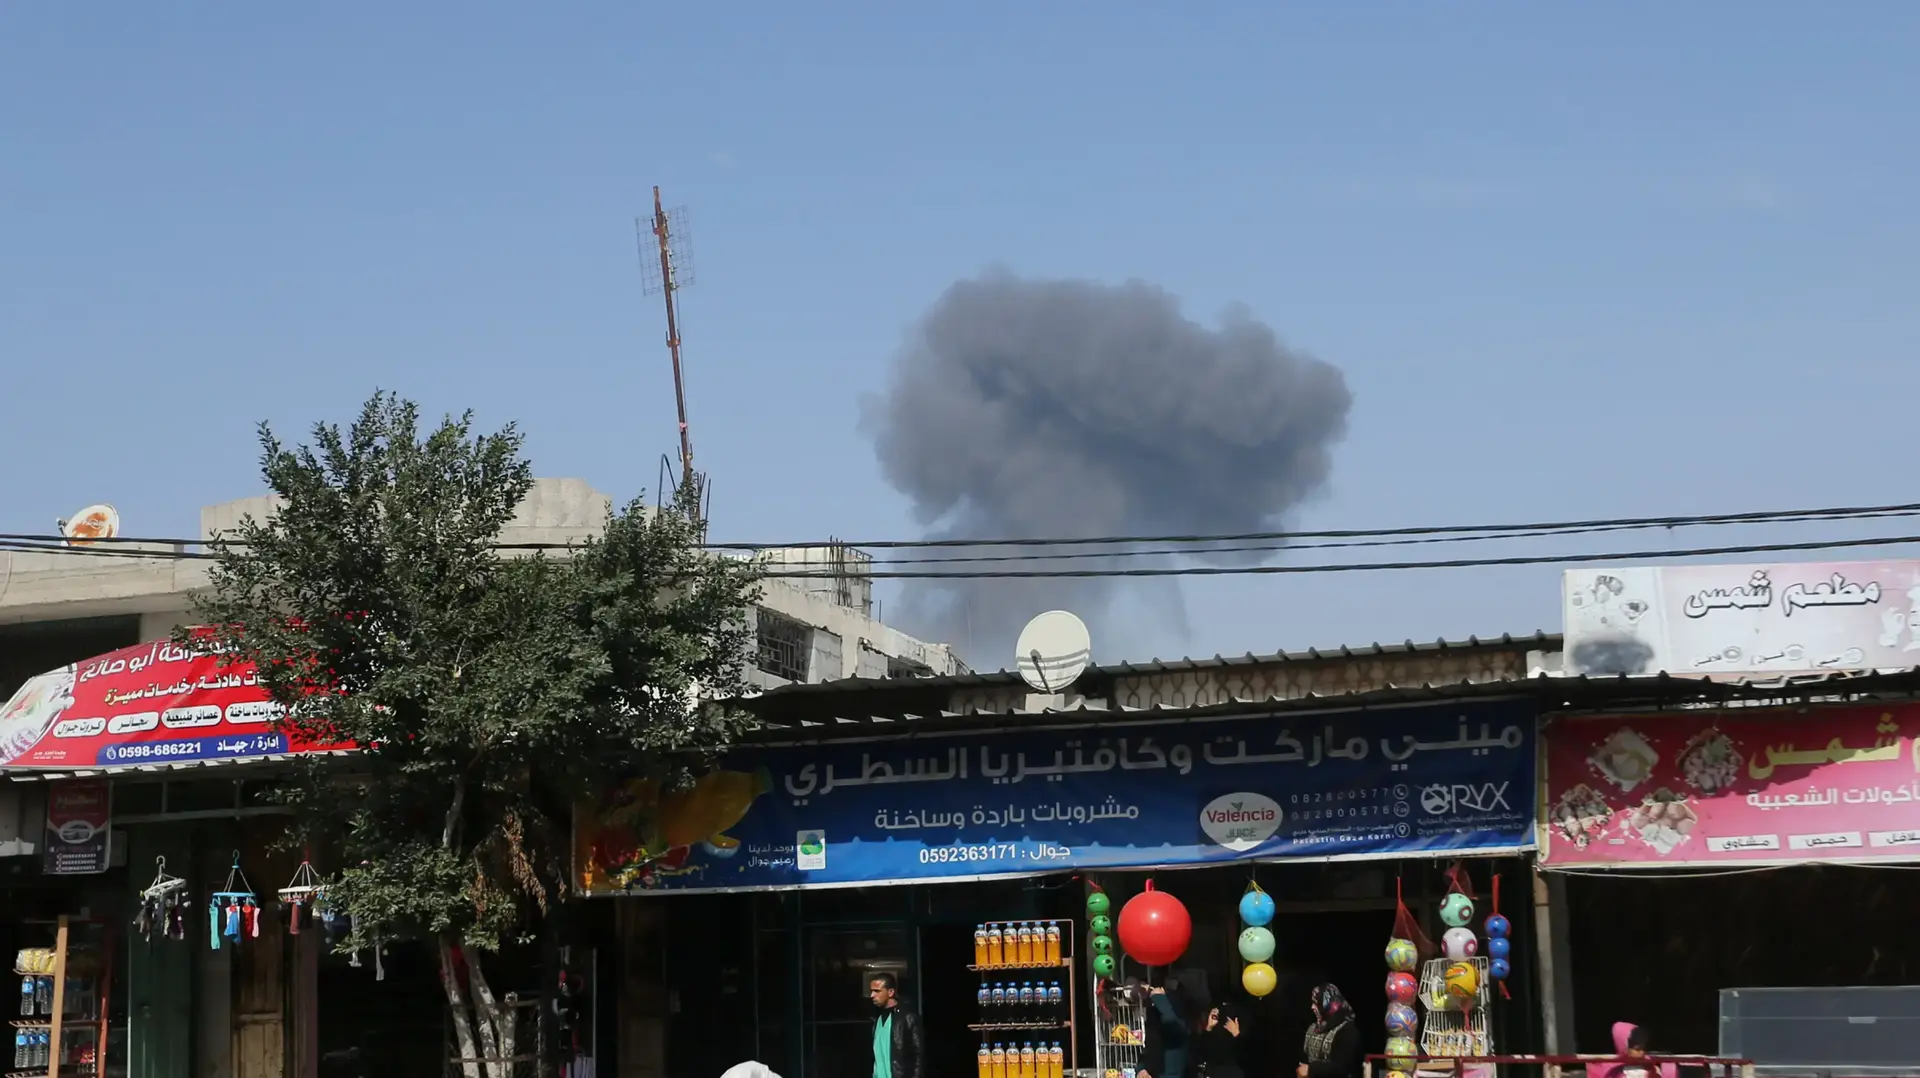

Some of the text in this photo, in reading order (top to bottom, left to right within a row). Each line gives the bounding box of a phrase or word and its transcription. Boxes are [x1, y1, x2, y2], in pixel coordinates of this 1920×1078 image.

[1684, 569, 1881, 618] مطعم شمس
[129, 643, 157, 673] أبو
[79, 658, 126, 682] صالح
[104, 688, 143, 705] مميزة
[144, 678, 197, 698] وخدمات
[165, 709, 219, 726] عصائر طبيعية
[119, 742, 201, 758] 0598-686221
[217, 739, 249, 753] جهاد
[1748, 712, 1901, 780] شمس
[785, 715, 1524, 806] ميني ماركت وكافتيريا السطري
[1747, 780, 1920, 810] أكولات الشعبية
[875, 794, 1139, 830] مشروبات باردة وساخنة
[1207, 808, 1275, 824] Valencia
[1226, 828, 1257, 838] JUICE
[1805, 835, 1848, 847] حمص
[919, 844, 1016, 864] 0592363171
[1029, 843, 1071, 860] جوال
